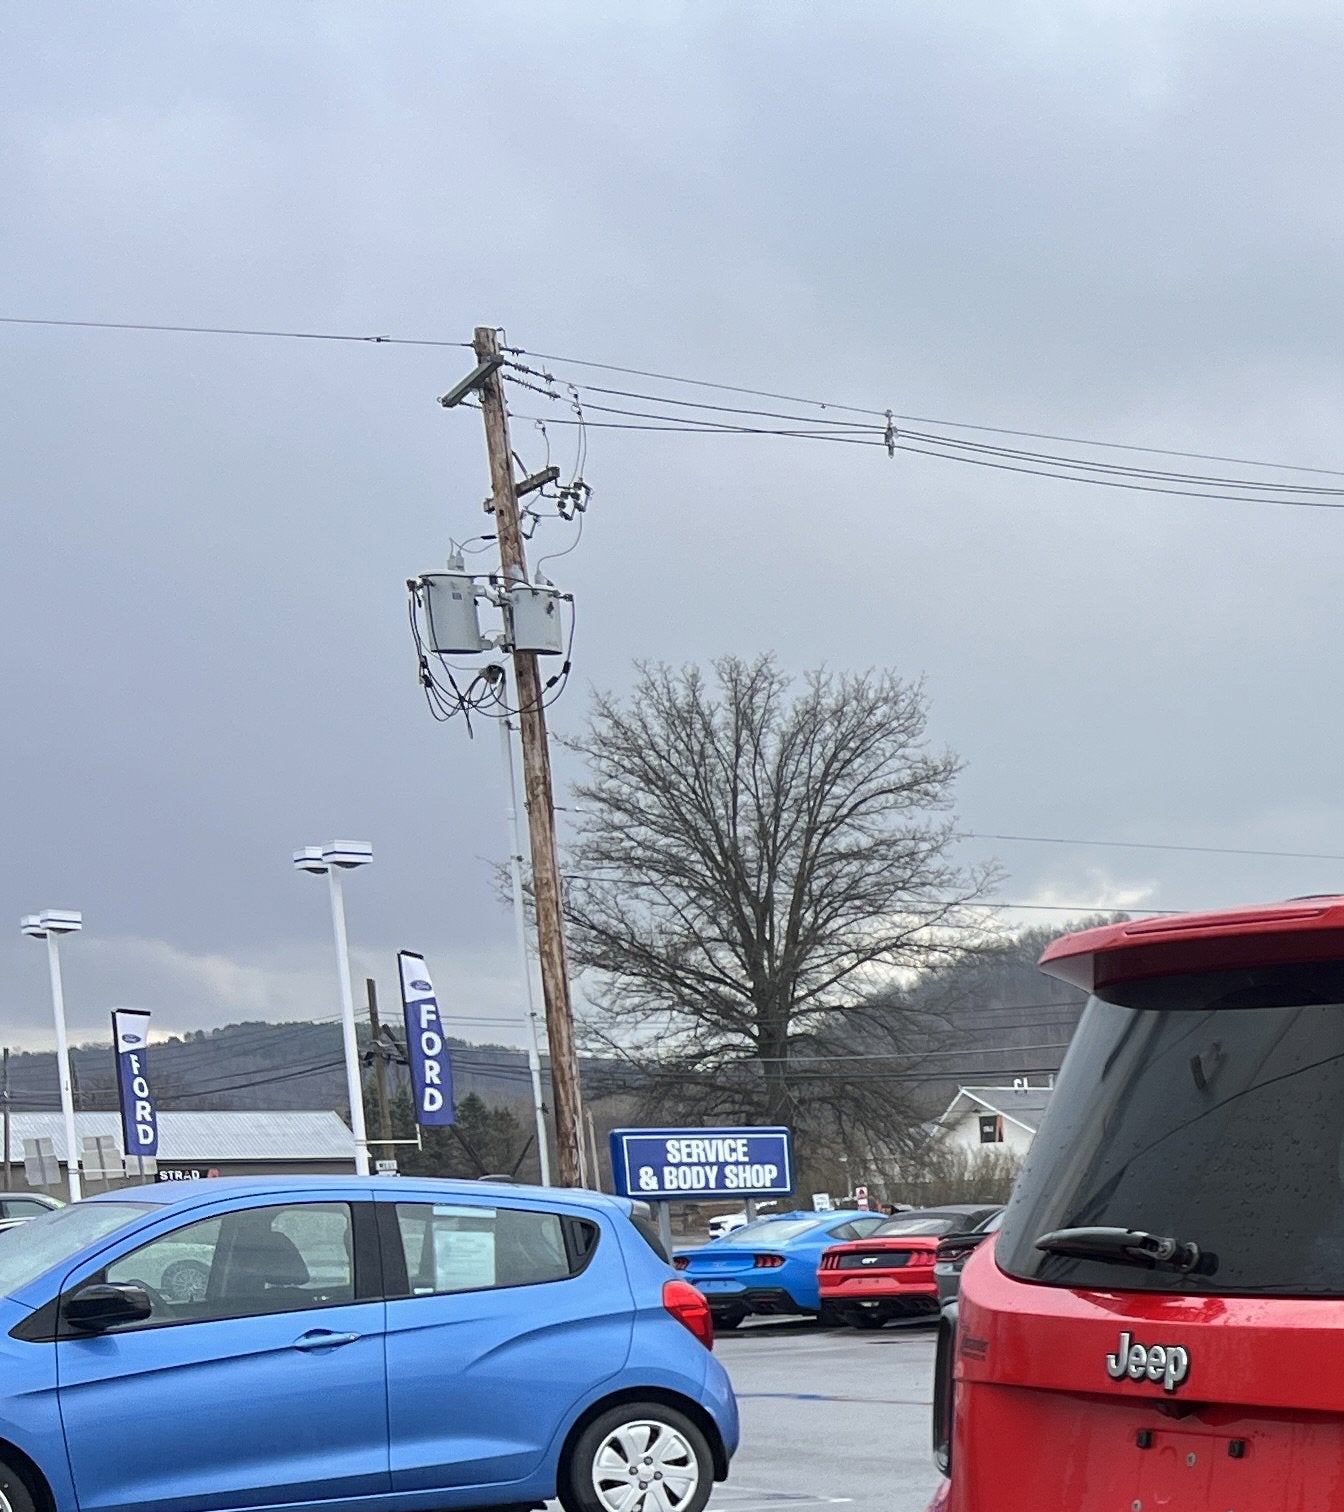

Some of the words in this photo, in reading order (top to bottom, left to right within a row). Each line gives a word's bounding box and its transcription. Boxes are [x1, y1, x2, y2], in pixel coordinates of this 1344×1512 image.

[420, 1004, 443, 1112] FORD
[130, 1054, 154, 1145] FORD
[639, 1166, 659, 1190] &
[663, 1165, 718, 1190] BODY
[724, 1164, 778, 1188] SHOP
[666, 1139, 749, 1163] SERVICE
[1105, 1331, 1188, 1391] Jeep
